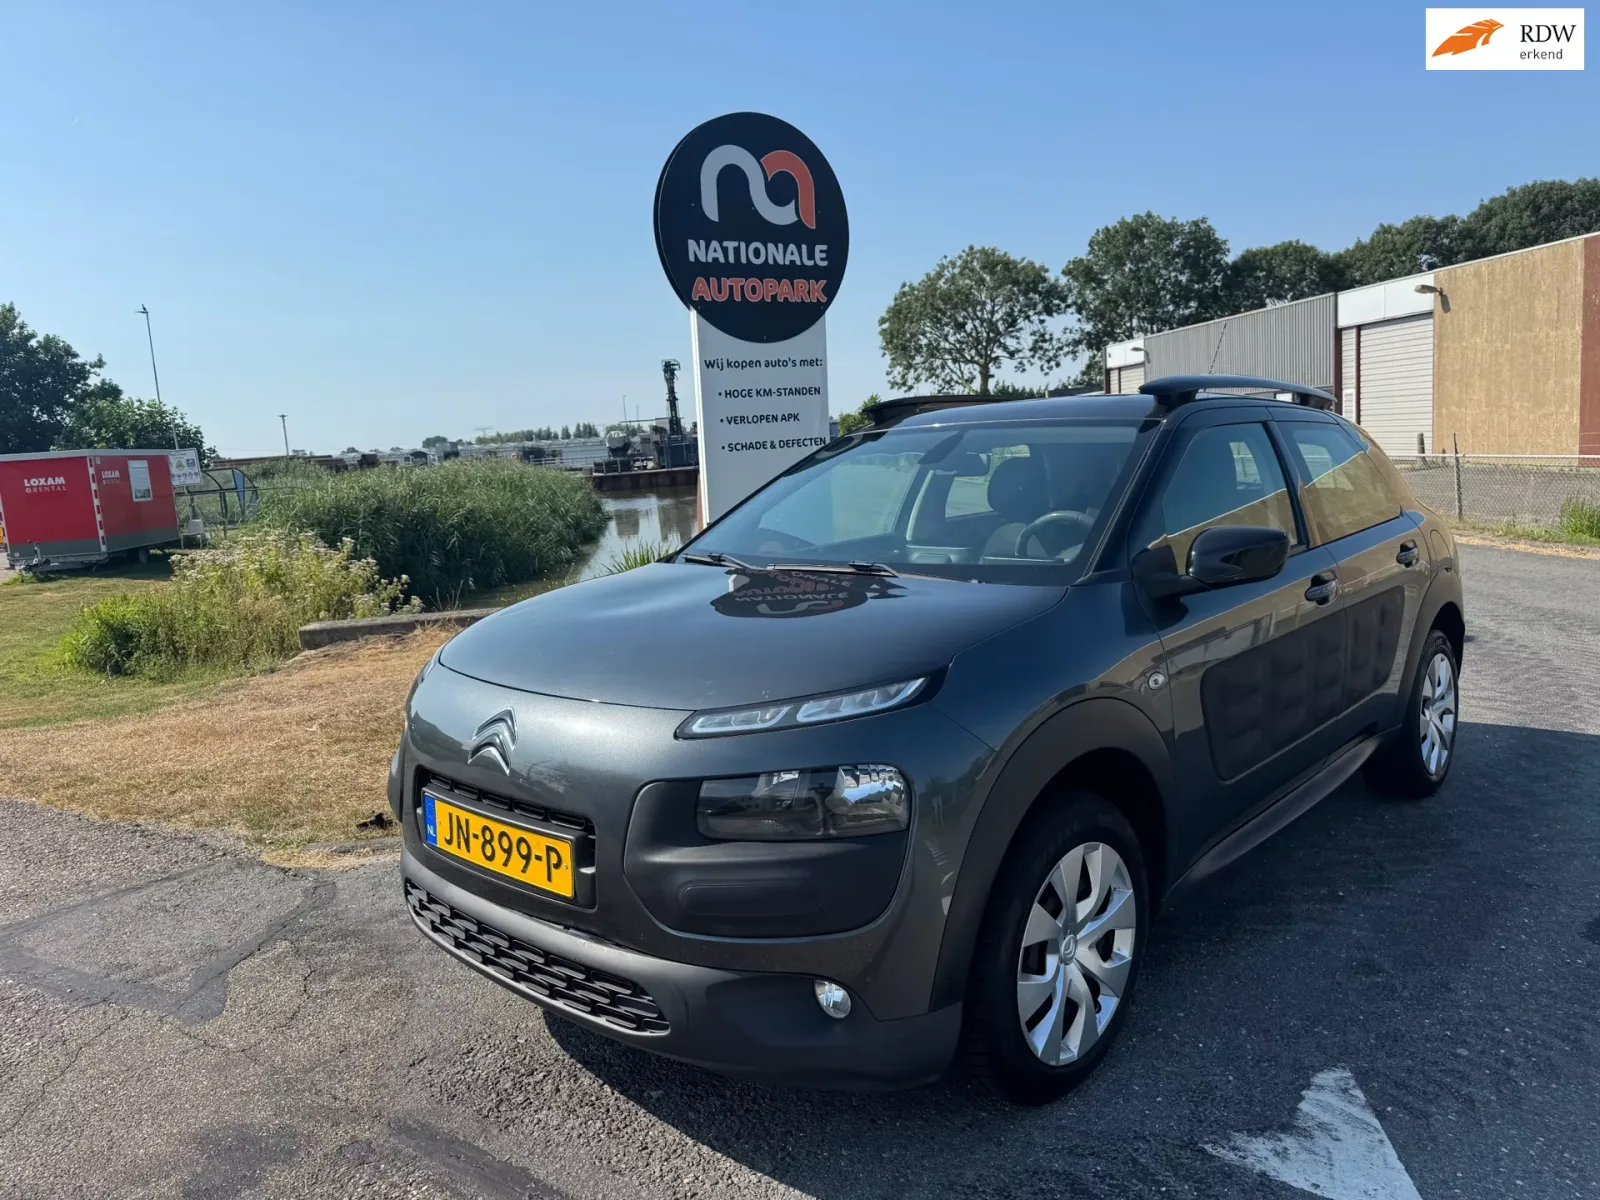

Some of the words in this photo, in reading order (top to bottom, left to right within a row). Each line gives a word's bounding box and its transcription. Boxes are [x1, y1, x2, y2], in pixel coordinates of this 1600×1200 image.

[687, 238, 828, 266] NATIONALE
[691, 276, 827, 303] AUTOPARK
[704, 358, 724, 371] Wij
[726, 358, 762, 371] kopen
[764, 356, 797, 368] auto's
[799, 357, 823, 368] met:
[724, 388, 753, 399] HOGE
[755, 386, 821, 398] KM-STANDEN
[726, 414, 779, 425] VERLOPEN
[780, 412, 800, 423] APK
[727, 440, 768, 452] SCHADE
[769, 439, 777, 450] &
[778, 437, 826, 448] DEFECTEN
[24, 476, 66, 487] LOXAM
[427, 823, 436, 837] NL
[444, 811, 563, 883] JN-899-P
